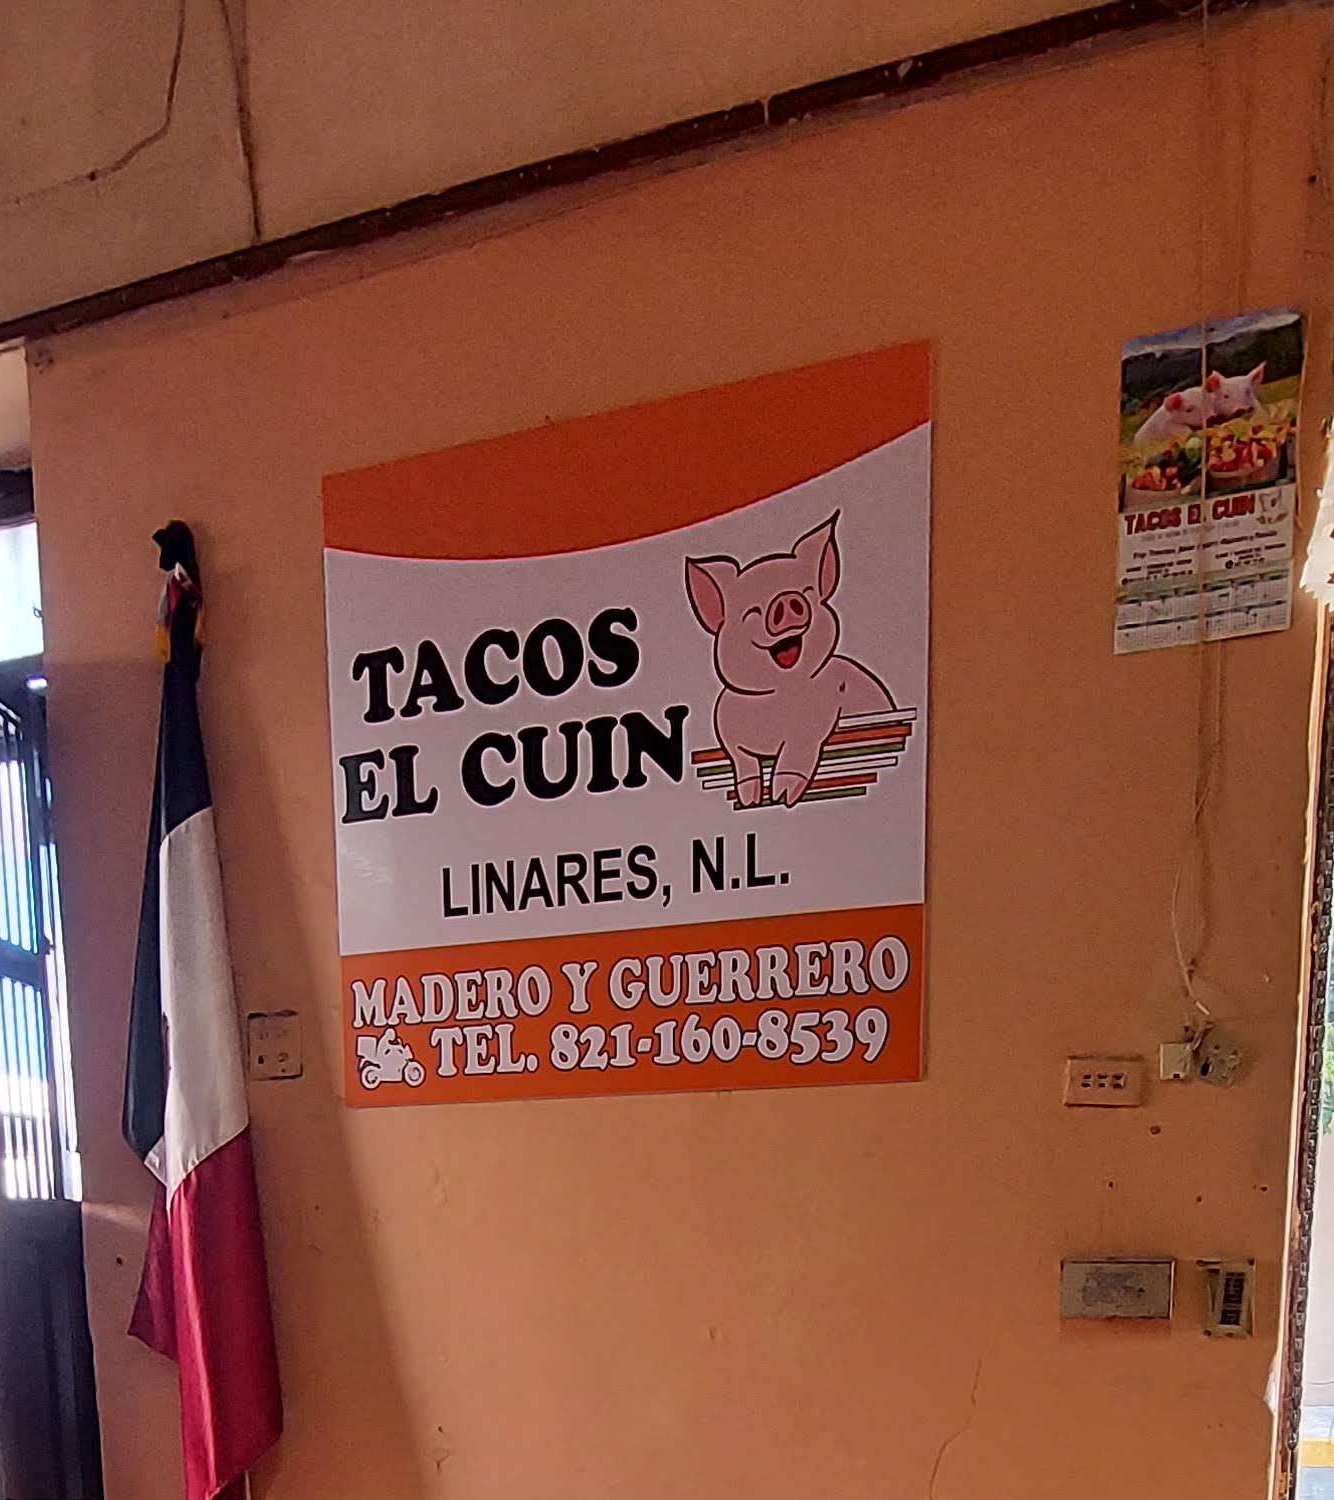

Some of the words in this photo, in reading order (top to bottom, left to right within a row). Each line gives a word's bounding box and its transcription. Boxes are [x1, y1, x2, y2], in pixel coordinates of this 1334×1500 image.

[1124, 507, 1182, 535] TACOS
[351, 606, 641, 725] TACOS
[338, 744, 440, 825] EL
[460, 703, 691, 807] CUIN
[441, 843, 672, 918] LINARES,
[692, 833, 791, 895] N.L.
[350, 965, 552, 1029] MADERO
[560, 960, 599, 1013] Y
[608, 935, 910, 1009] GUERRERO
[429, 1022, 539, 1077] TEL.
[549, 1007, 890, 1071] 821-160-8539
